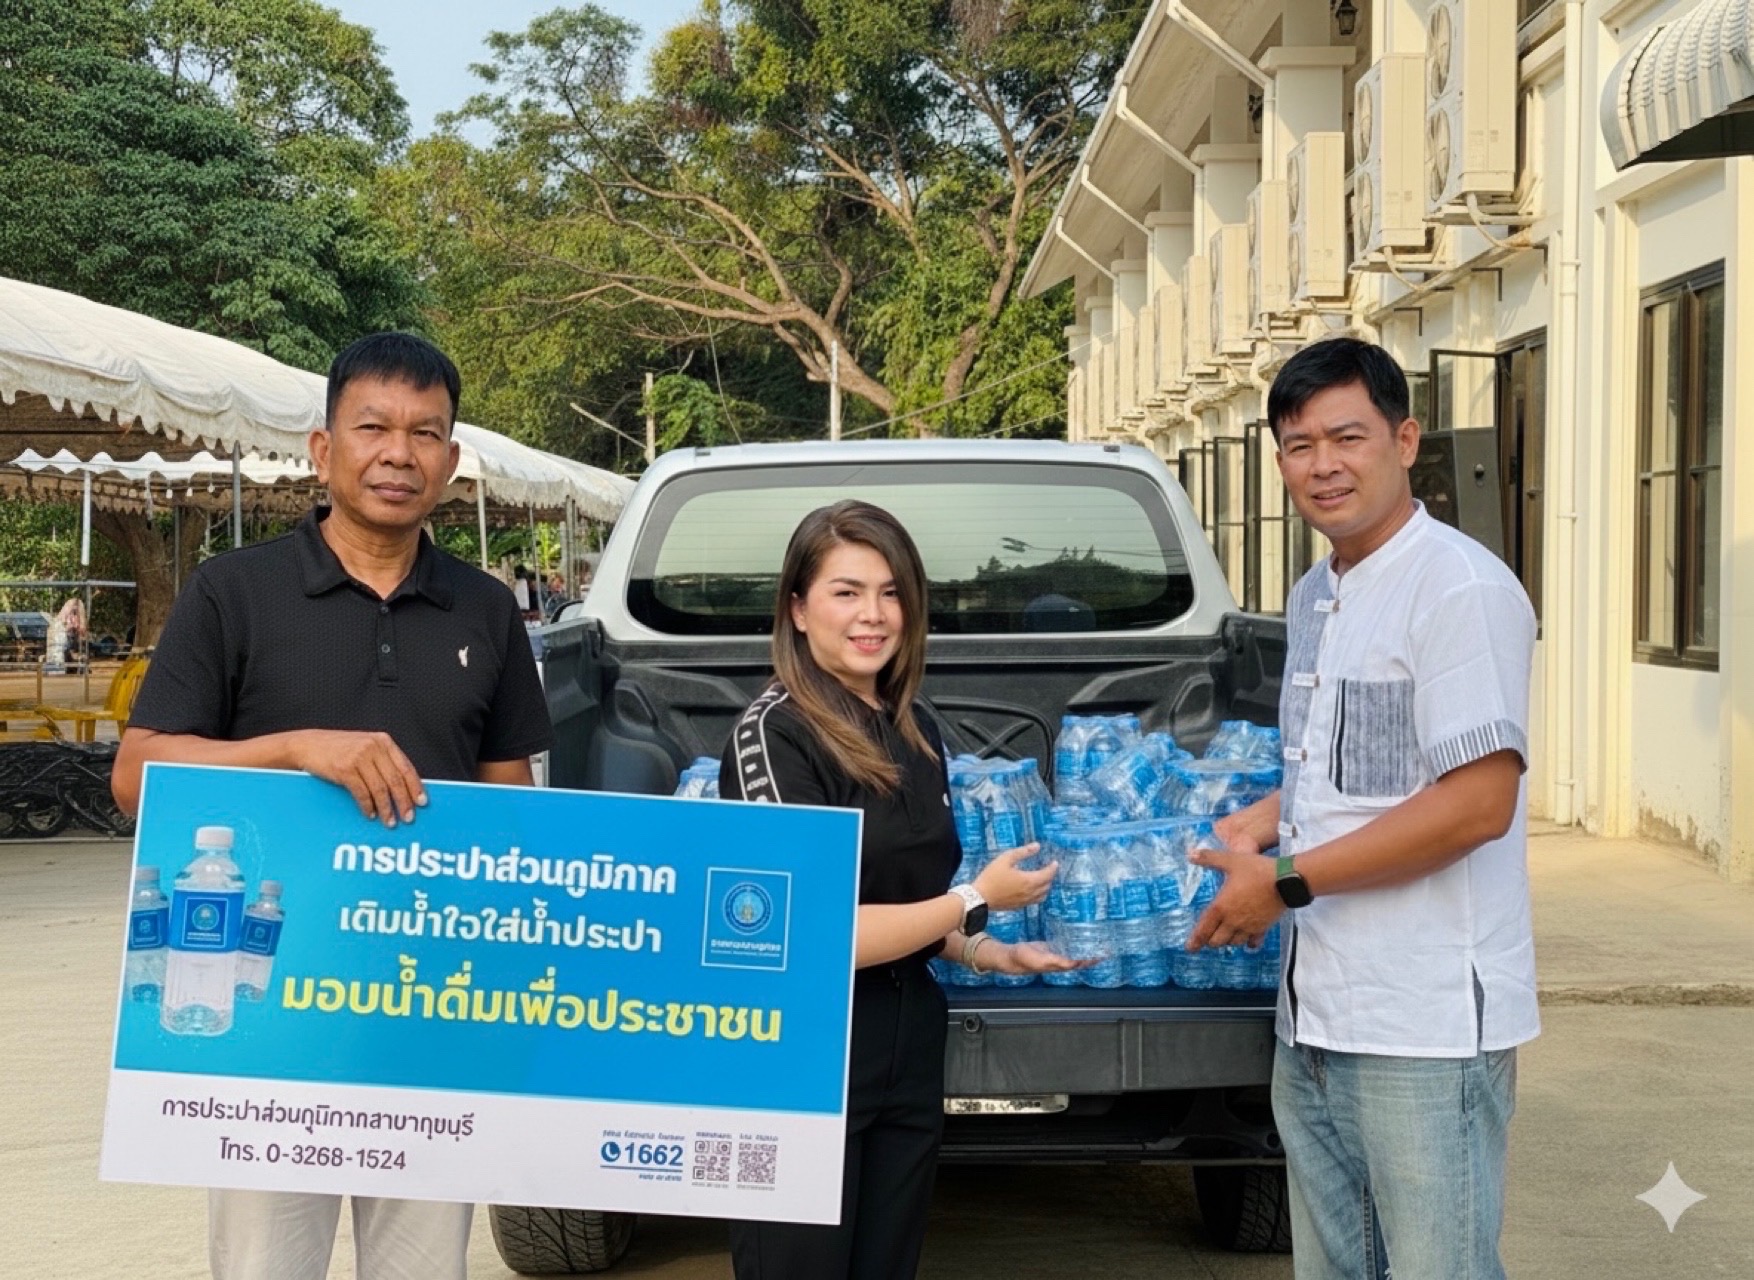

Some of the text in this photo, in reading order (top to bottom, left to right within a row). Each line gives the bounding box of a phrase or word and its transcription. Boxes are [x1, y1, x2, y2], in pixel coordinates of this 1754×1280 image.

[333, 842, 676, 898] การประปาส่วนภูมิภาค
[340, 890, 662, 952] เติมน้ำใจใส่น้ำประปา
[282, 954, 782, 1041] มอบน้ำดื่มเพื่อประชาชน
[266, 1143, 406, 1170] 0-3268-1524
[624, 1142, 684, 1167] 1662
